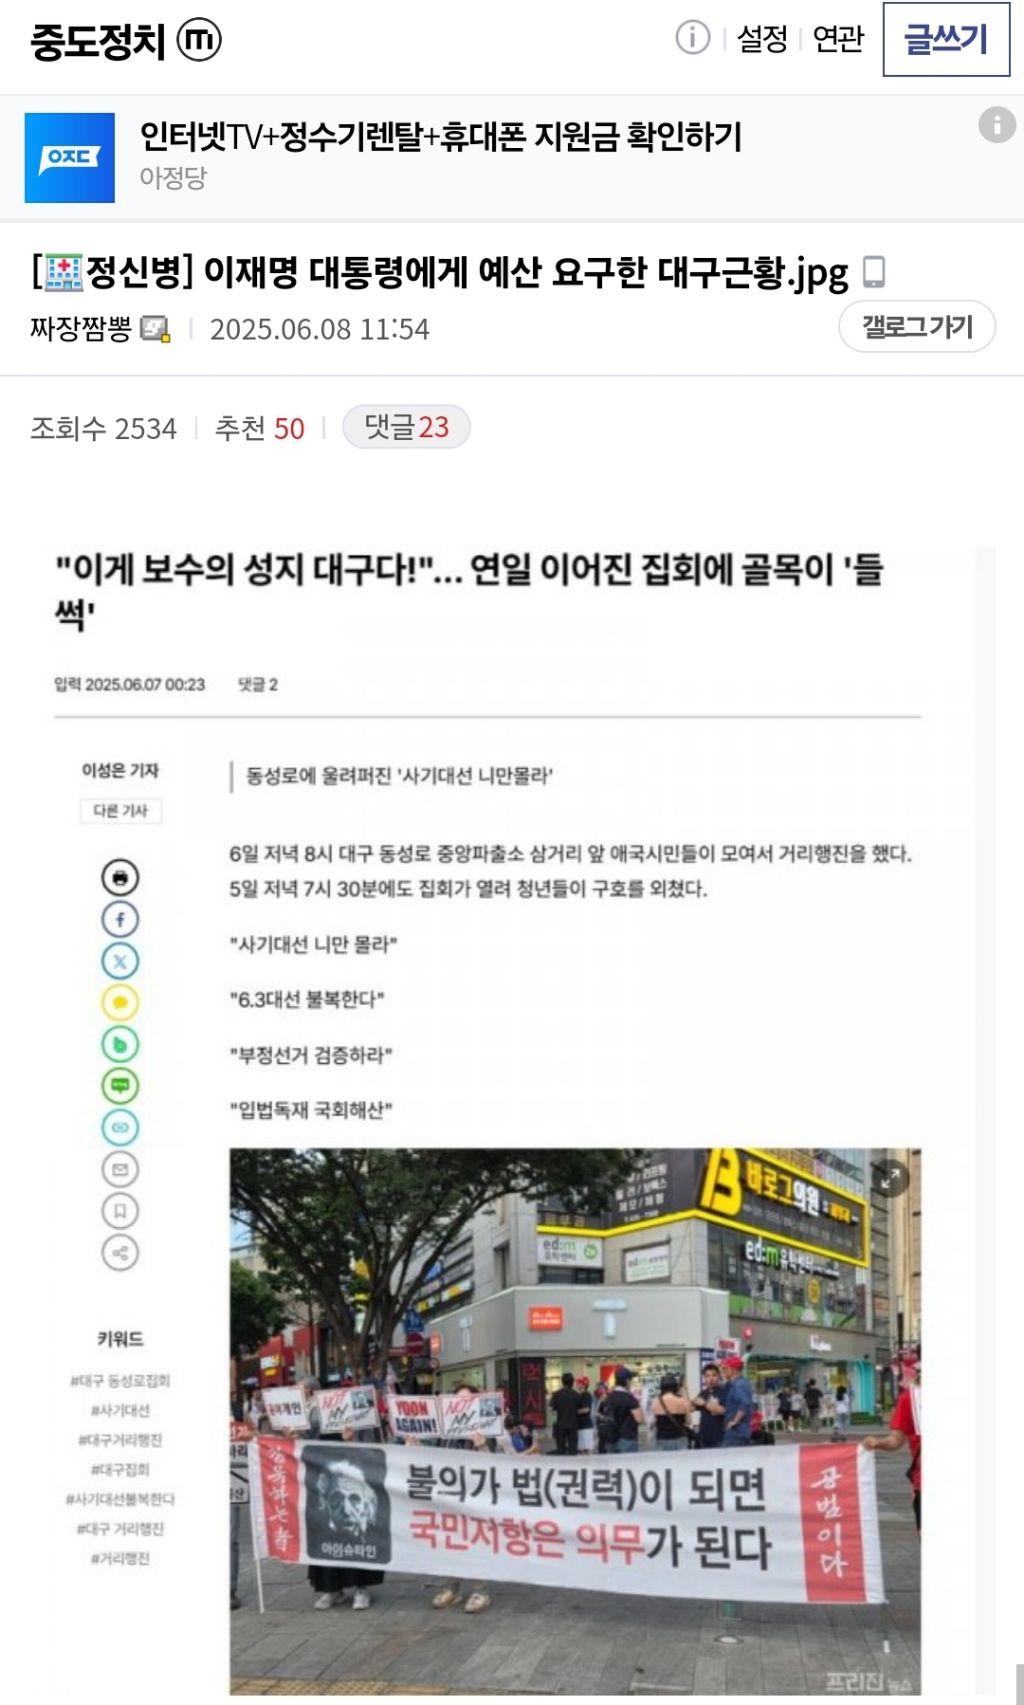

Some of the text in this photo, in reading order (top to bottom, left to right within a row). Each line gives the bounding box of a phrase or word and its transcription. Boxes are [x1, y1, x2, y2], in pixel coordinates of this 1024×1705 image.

[31, 24, 164, 62] 중도정치
[737, 25, 786, 53] 설정
[814, 25, 865, 53] 연관
[904, 24, 986, 55] 글쓰기
[141, 121, 740, 153] 인터넷TV+정수기렌탈+휴대폰 지원금 확인하기
[140, 166, 207, 190] 아정당
[205, 256, 297, 289] 이재명
[310, 256, 467, 290] 대통령에게
[479, 256, 542, 289] 예산
[552, 256, 648, 289] 요구한
[659, 255, 849, 295] 대구근황.jpg
[30, 316, 132, 343] 짜장짬뽕
[211, 318, 429, 340] 2025.06.08 11:54
[862, 314, 973, 340] 갤로그 가기
[31, 416, 177, 442] 조회수 2534
[216, 416, 304, 442] 추천 50
[57, 552, 884, 587] "이게 보수의 성지 대구다!"... 연일 이어진 집회에 골목이 '들
[55, 598, 94, 633] 썩'
[54, 677, 205, 692] 입력 2025.06.07 00:23
[239, 677, 278, 692] 댓글 2
[82, 763, 159, 779] 이성은 기자
[246, 766, 553, 786] 동성로에 울려퍼진 '사기대선 니만몰라'
[94, 804, 148, 818] 다른 기사
[230, 844, 912, 864] 6일 저녁 8시 대구 동성로 중앙파출소 삼거리 앞 애국시민들이 모여서 거리행진을 했다.
[230, 879, 707, 899] 5일 저녁 7시 30분에도 집회가 열려 청년들이 구호를 외쳤다.
[230, 935, 397, 955] "사기대선 니만 몰라"
[230, 990, 384, 1009] "6.3대선 불복한다"
[230, 1046, 392, 1065] "부정선거 검증하라"
[230, 1101, 392, 1120] "입법독재 국회해산"
[98, 1330, 144, 1348] 키워드
[71, 1374, 170, 1388] #대구 동성로집회
[91, 1404, 150, 1418] #사기대선
[395, 1400, 428, 1416] YOON
[395, 1417, 437, 1434] AGAIN!
[79, 1433, 162, 1448] #대구거리행진
[91, 1463, 149, 1477] #대구집회
[407, 1464, 767, 1513] 불의가 법(권력)이 되면
[66, 1493, 175, 1506] #사기대선불복한다
[77, 1522, 164, 1536] #대구 거리행진
[811, 1466, 849, 1579] 공범이다
[409, 1509, 772, 1571] 국민저항은 의무가 된다
[91, 1552, 150, 1566] #거리행진
